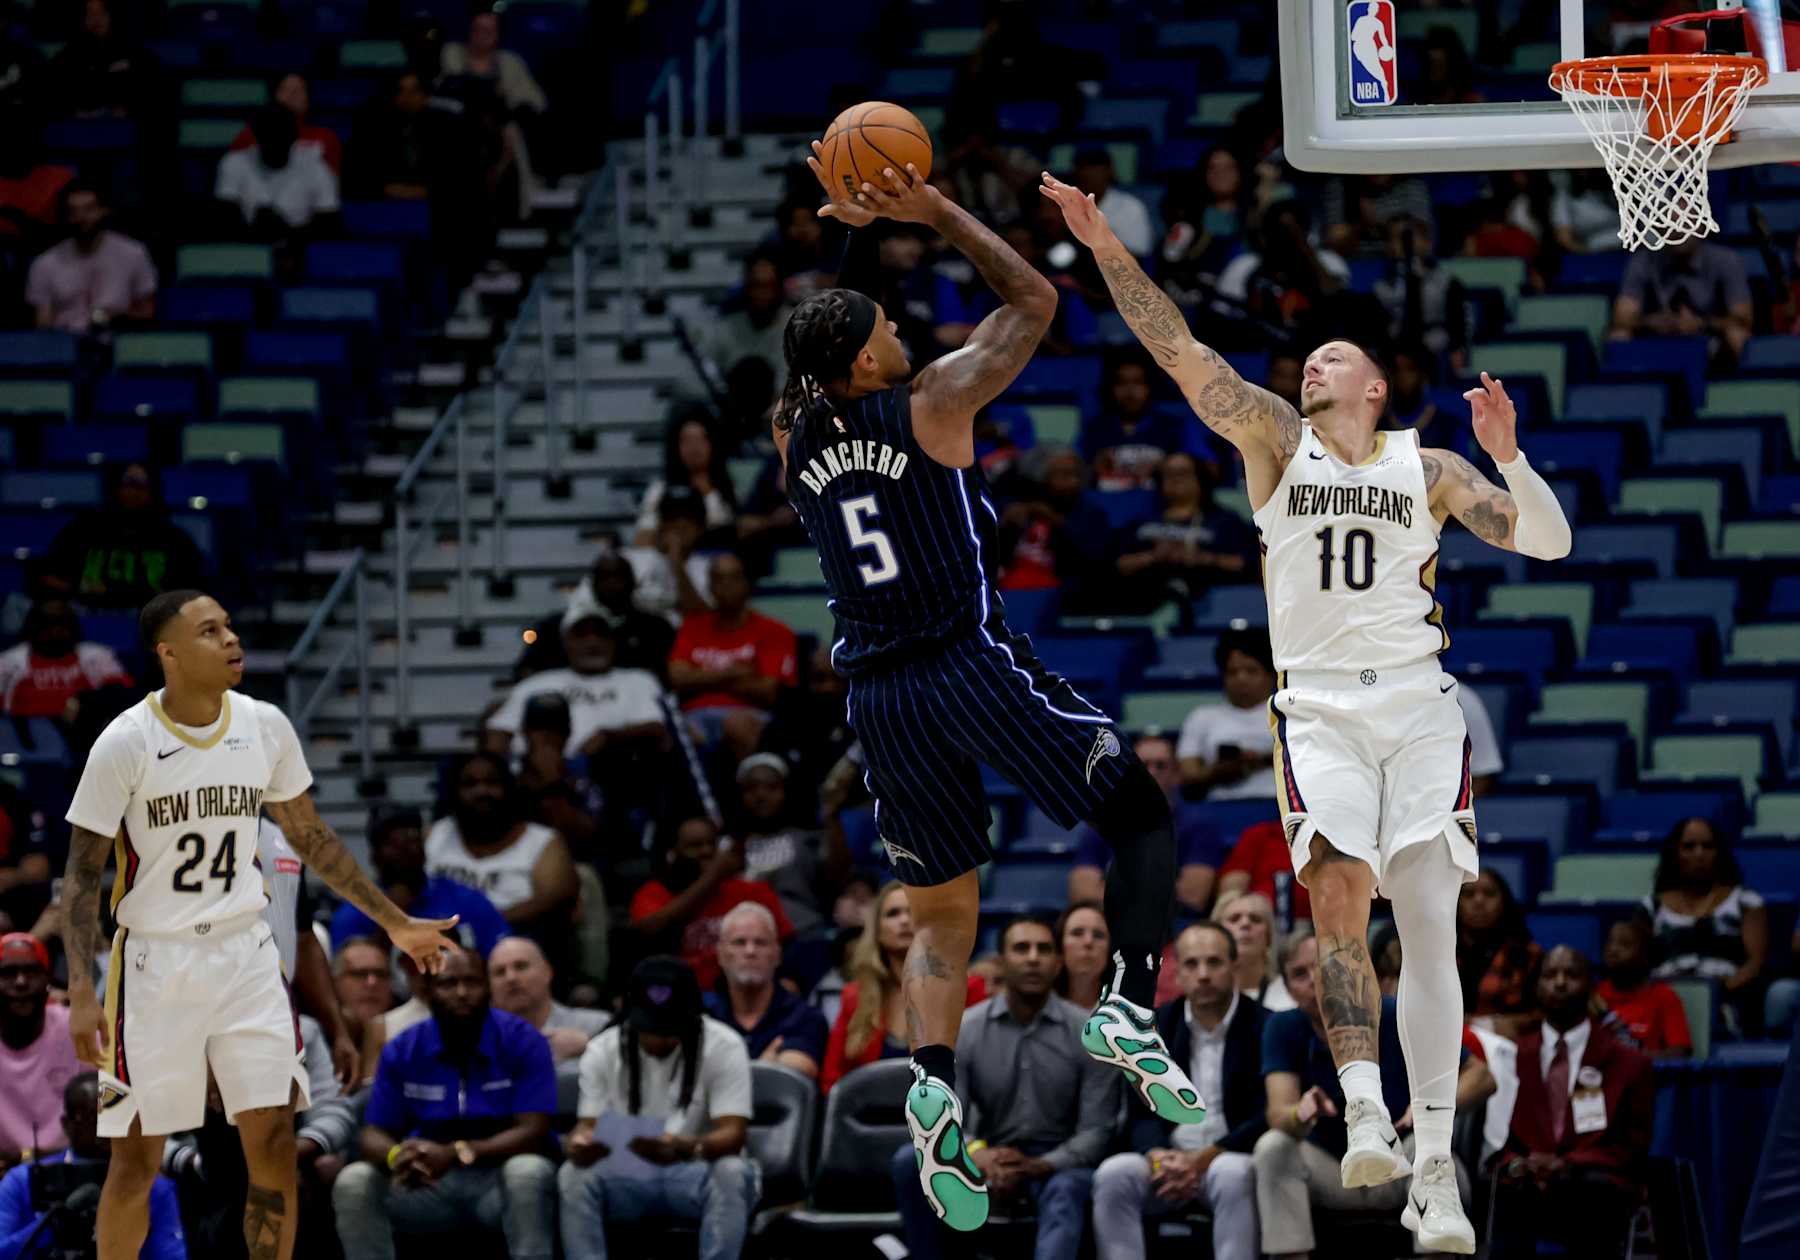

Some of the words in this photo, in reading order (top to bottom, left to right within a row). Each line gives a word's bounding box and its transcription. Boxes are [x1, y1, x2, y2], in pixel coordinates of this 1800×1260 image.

[1357, 81, 1380, 99] NBA
[799, 439, 909, 496] BANCHERO
[838, 492, 901, 587] 5
[1316, 526, 1376, 591] 10
[146, 790, 189, 829] NEW
[173, 830, 235, 894] 24
